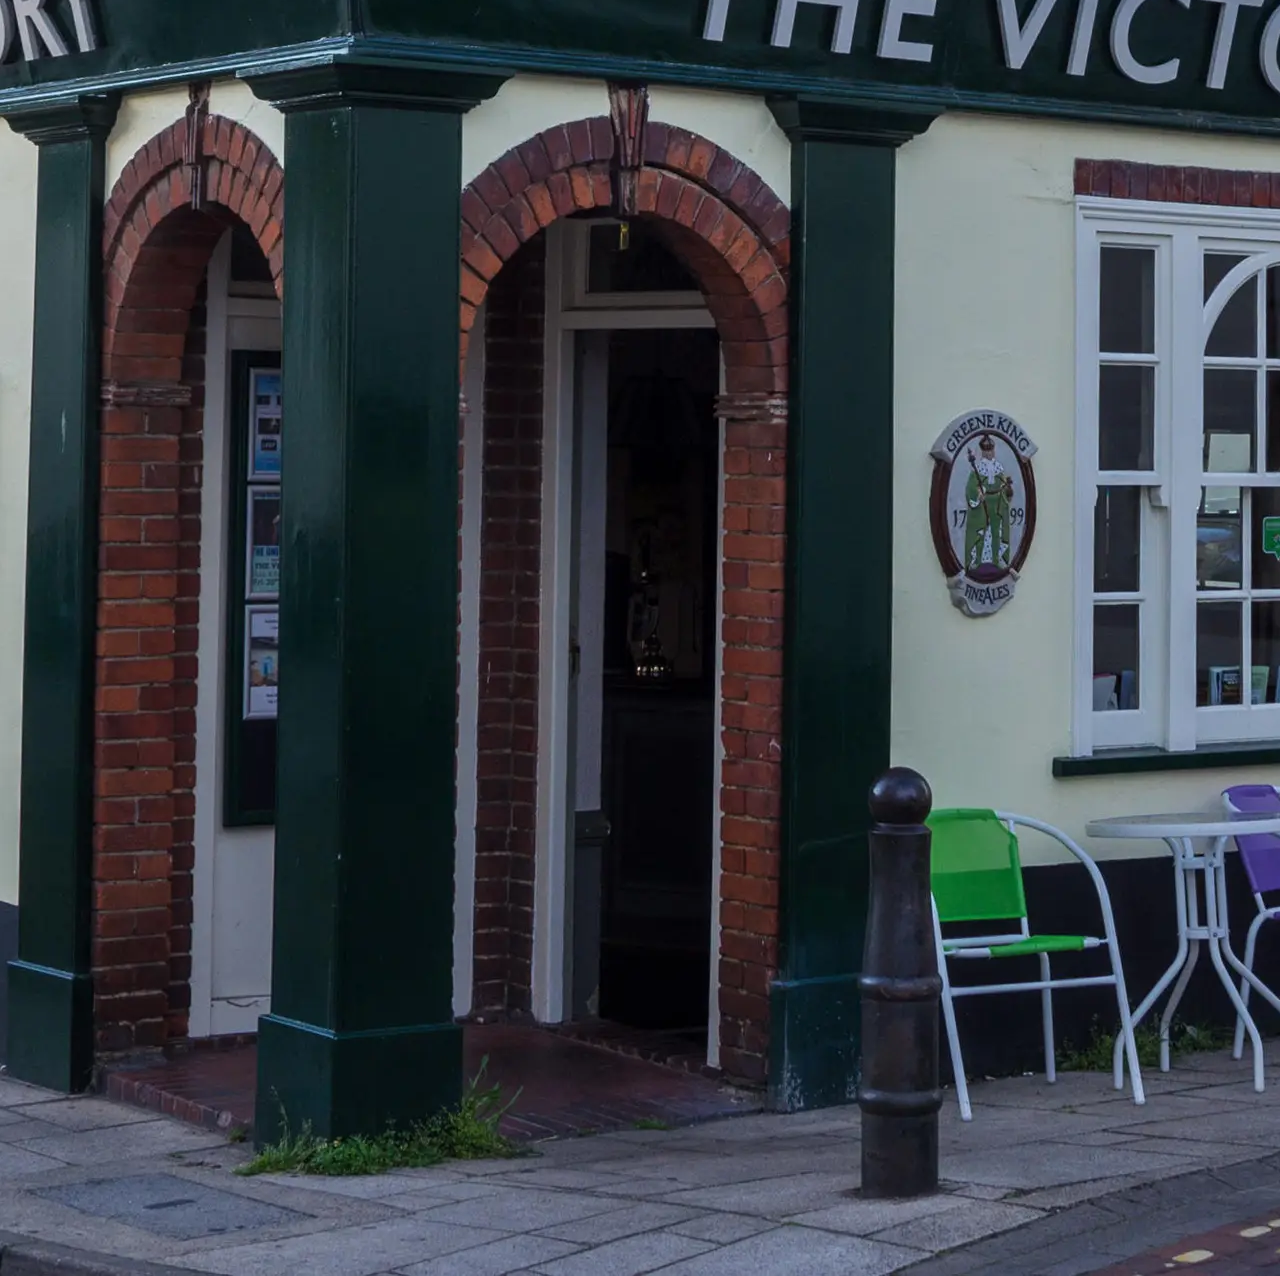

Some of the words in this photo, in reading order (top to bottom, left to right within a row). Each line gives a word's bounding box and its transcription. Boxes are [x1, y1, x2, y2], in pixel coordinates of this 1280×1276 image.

[946, 414, 995, 453] GREENE
[997, 416, 1030, 452] KING
[953, 510, 967, 528] 17
[1010, 508, 1024, 525] 99
[964, 584, 984, 602] FINE
[982, 584, 1010, 605] ALES
